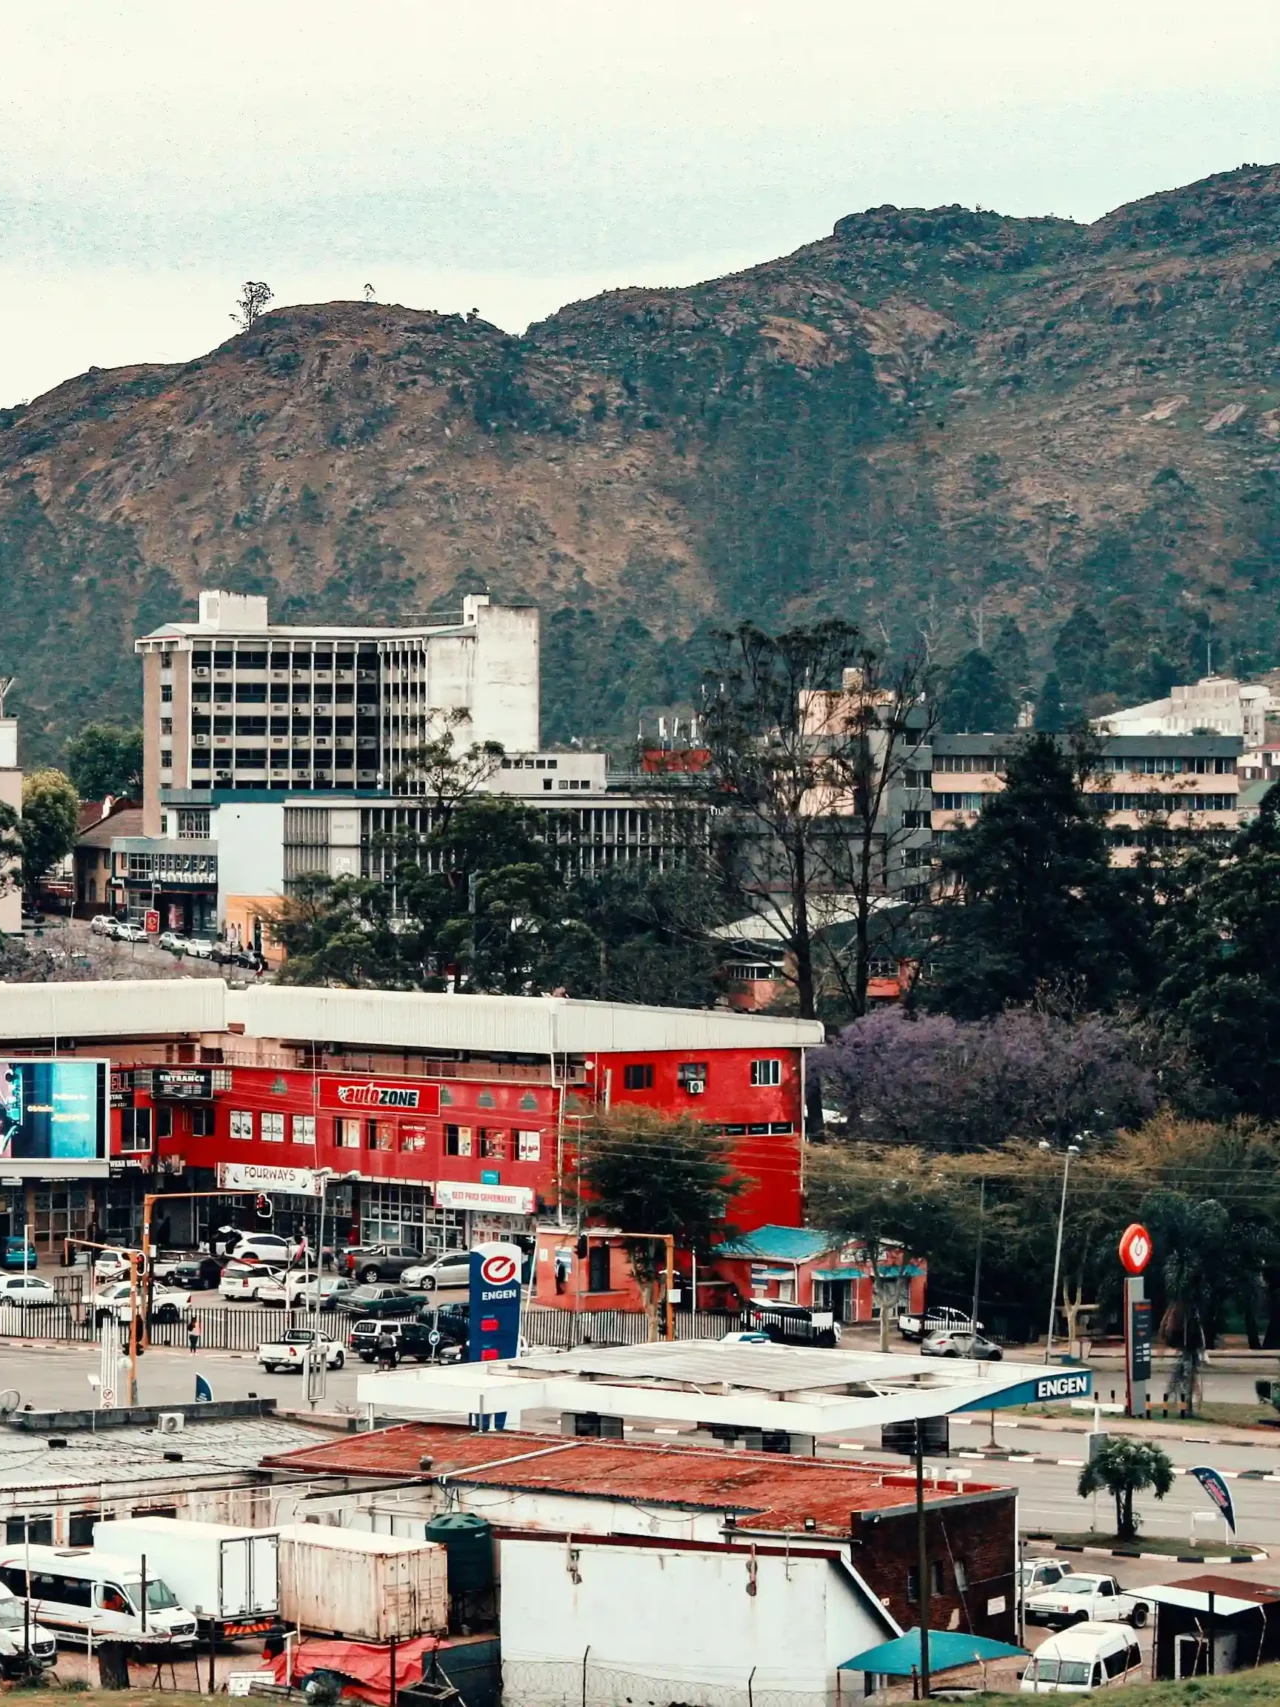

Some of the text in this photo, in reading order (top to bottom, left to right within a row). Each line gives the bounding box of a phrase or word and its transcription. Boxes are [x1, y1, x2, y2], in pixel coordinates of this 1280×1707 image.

[244, 1166, 296, 1181] FOURWAYS
[482, 1289, 517, 1301] ENGEN
[1038, 1376, 1087, 1397] ENGEN
